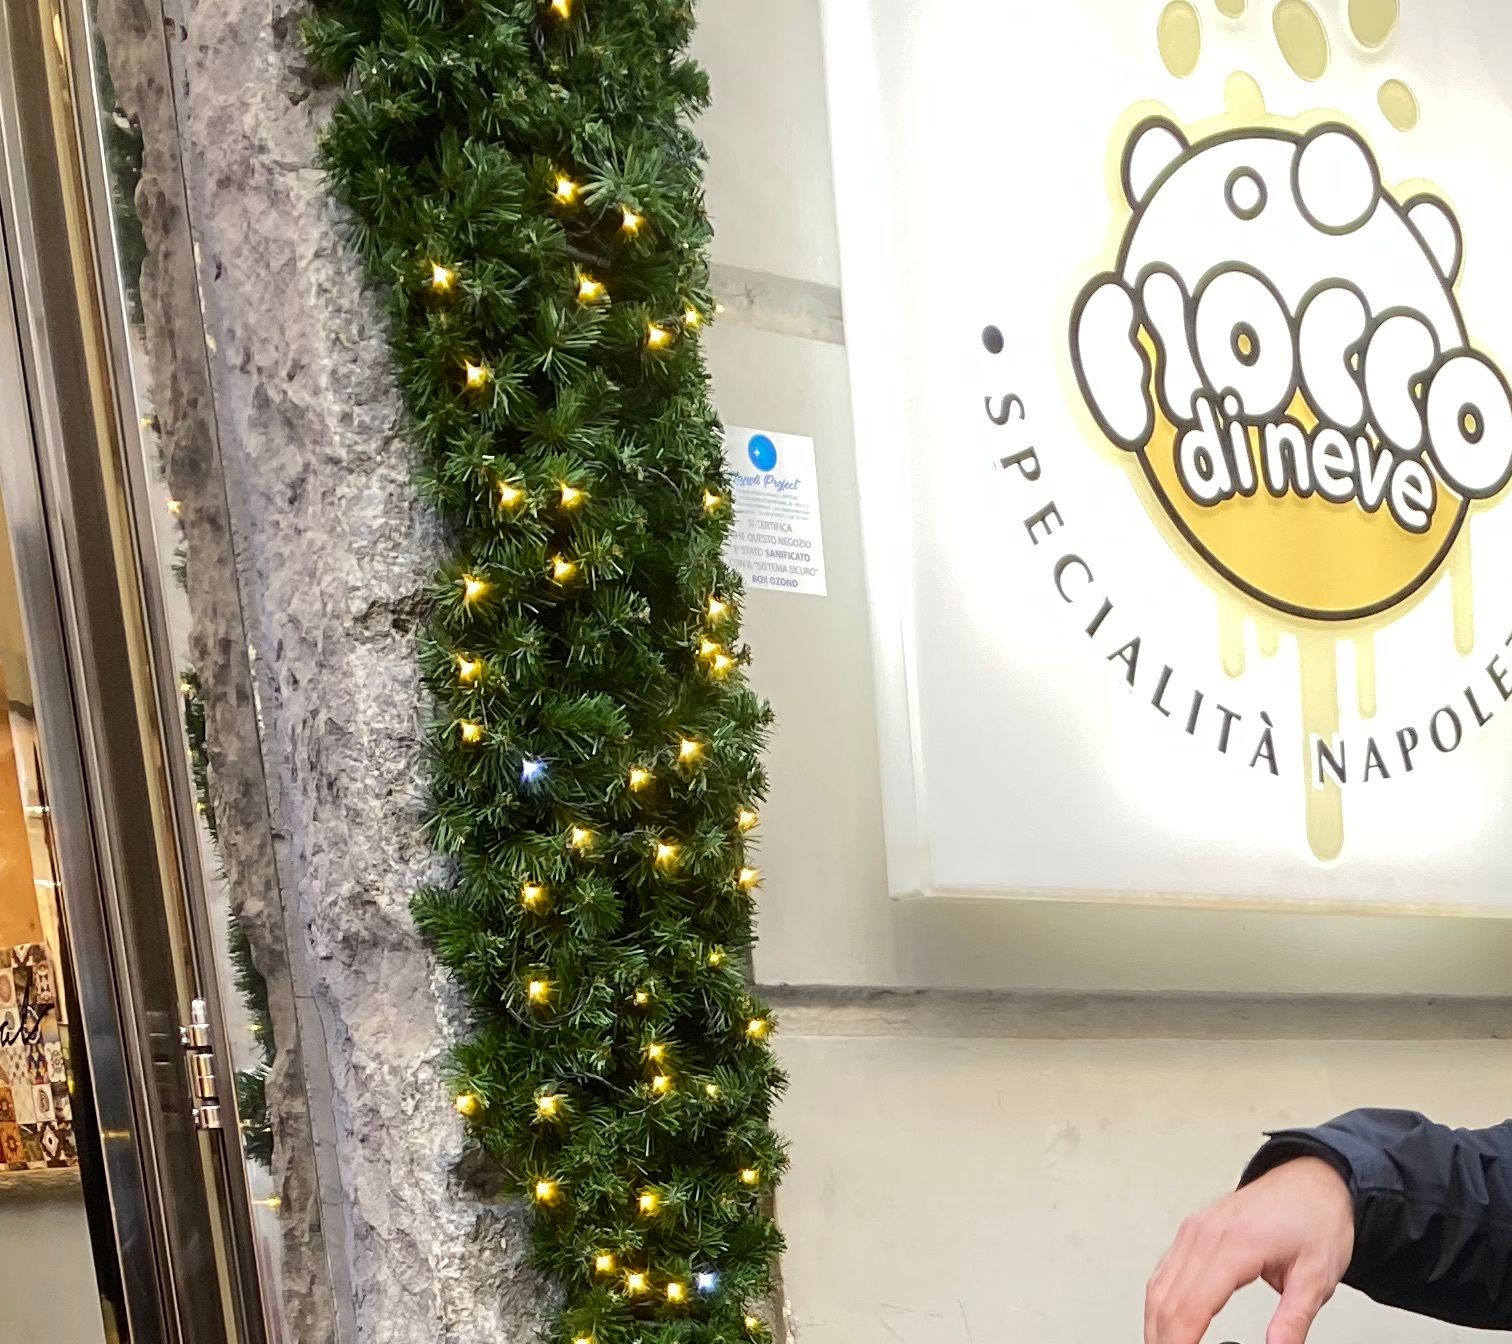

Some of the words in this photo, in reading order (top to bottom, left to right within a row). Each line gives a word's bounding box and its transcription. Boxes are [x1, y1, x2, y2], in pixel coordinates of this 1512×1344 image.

[1260, 421, 1437, 534] neve
[747, 532, 776, 545] QUESTO
[778, 536, 811, 549] NEGOZIO
[765, 548, 811, 562] SANIFICATO
[752, 574, 768, 584] BOX
[770, 576, 798, 588] OZONO
[984, 392, 1281, 778] SPECIALITÀ
